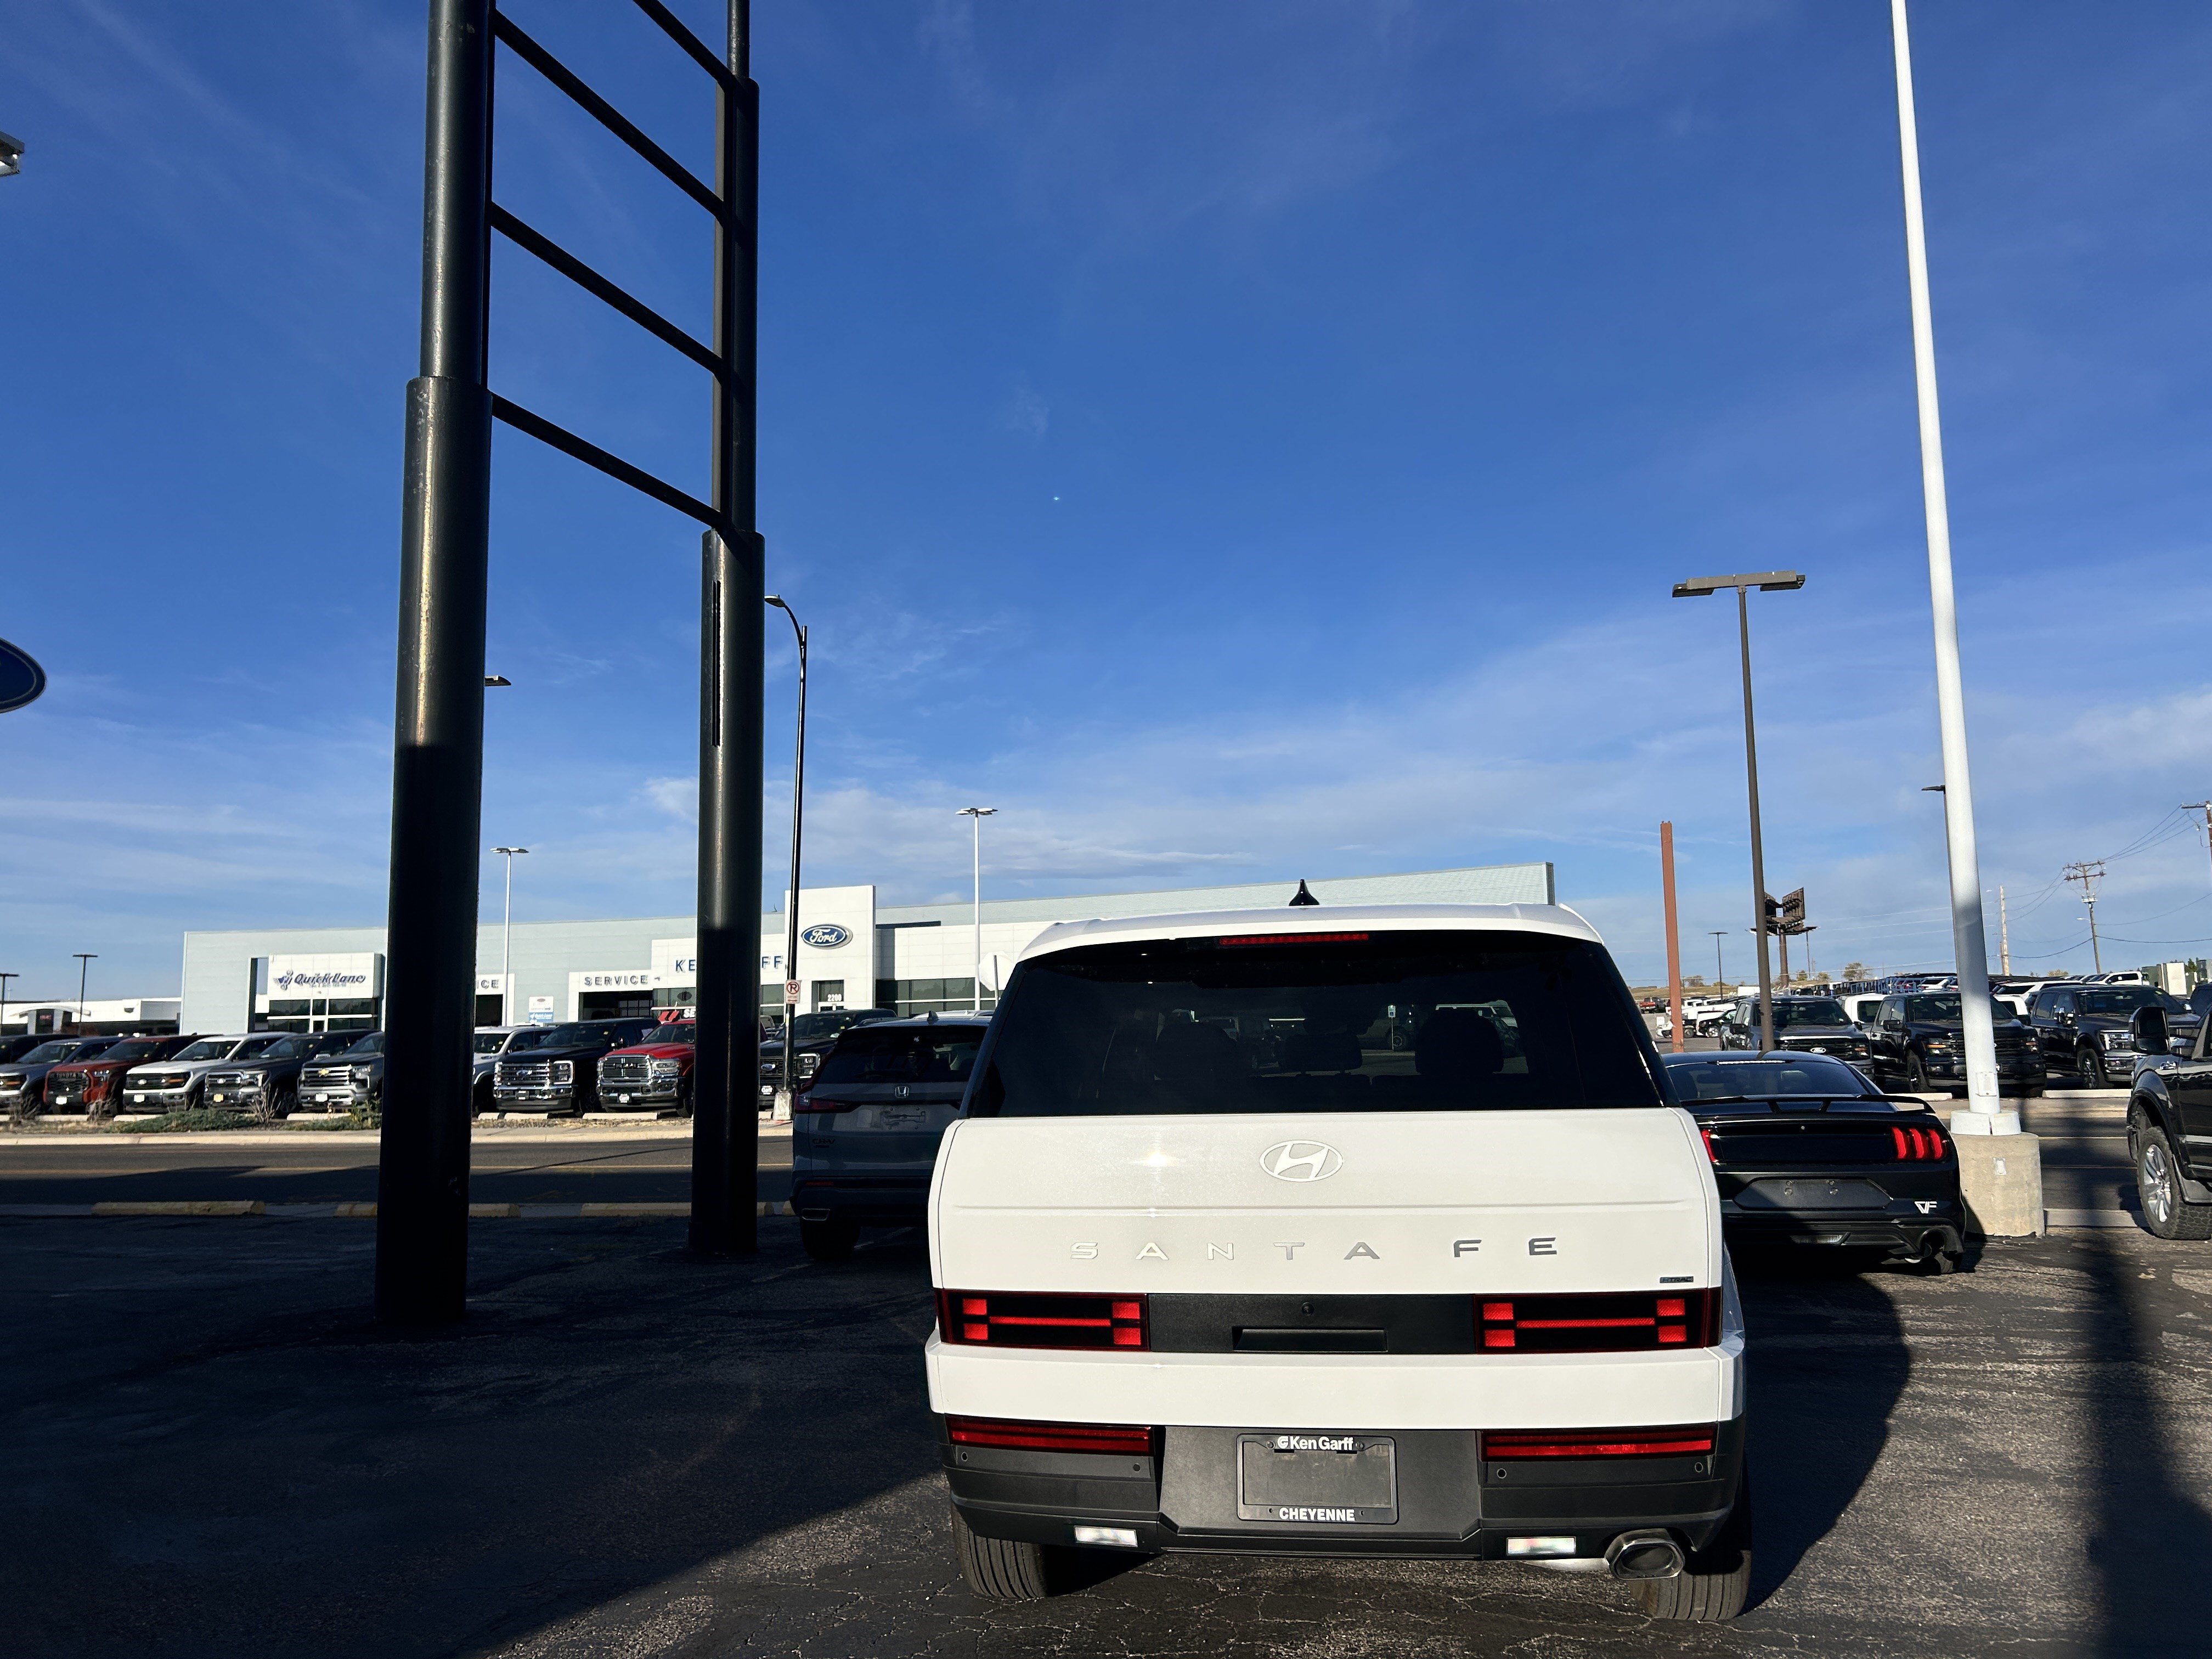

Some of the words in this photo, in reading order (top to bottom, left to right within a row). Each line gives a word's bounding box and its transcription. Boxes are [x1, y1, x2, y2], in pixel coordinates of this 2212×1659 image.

[809, 928, 837, 943] Ford
[675, 959, 696, 972] KE
[294, 973, 330, 985] Quick
[331, 973, 364, 984] Lane
[584, 975, 648, 986] SERVICE
[827, 994, 842, 1002] 2200
[684, 1008, 696, 1018] SE
[1070, 1242, 1380, 1260] SANTA
[1453, 1237, 1558, 1258] FE
[1290, 1436, 1317, 1449] Ken
[1318, 1436, 1353, 1450] Garff
[1279, 1508, 1355, 1521] CHEYENNE
